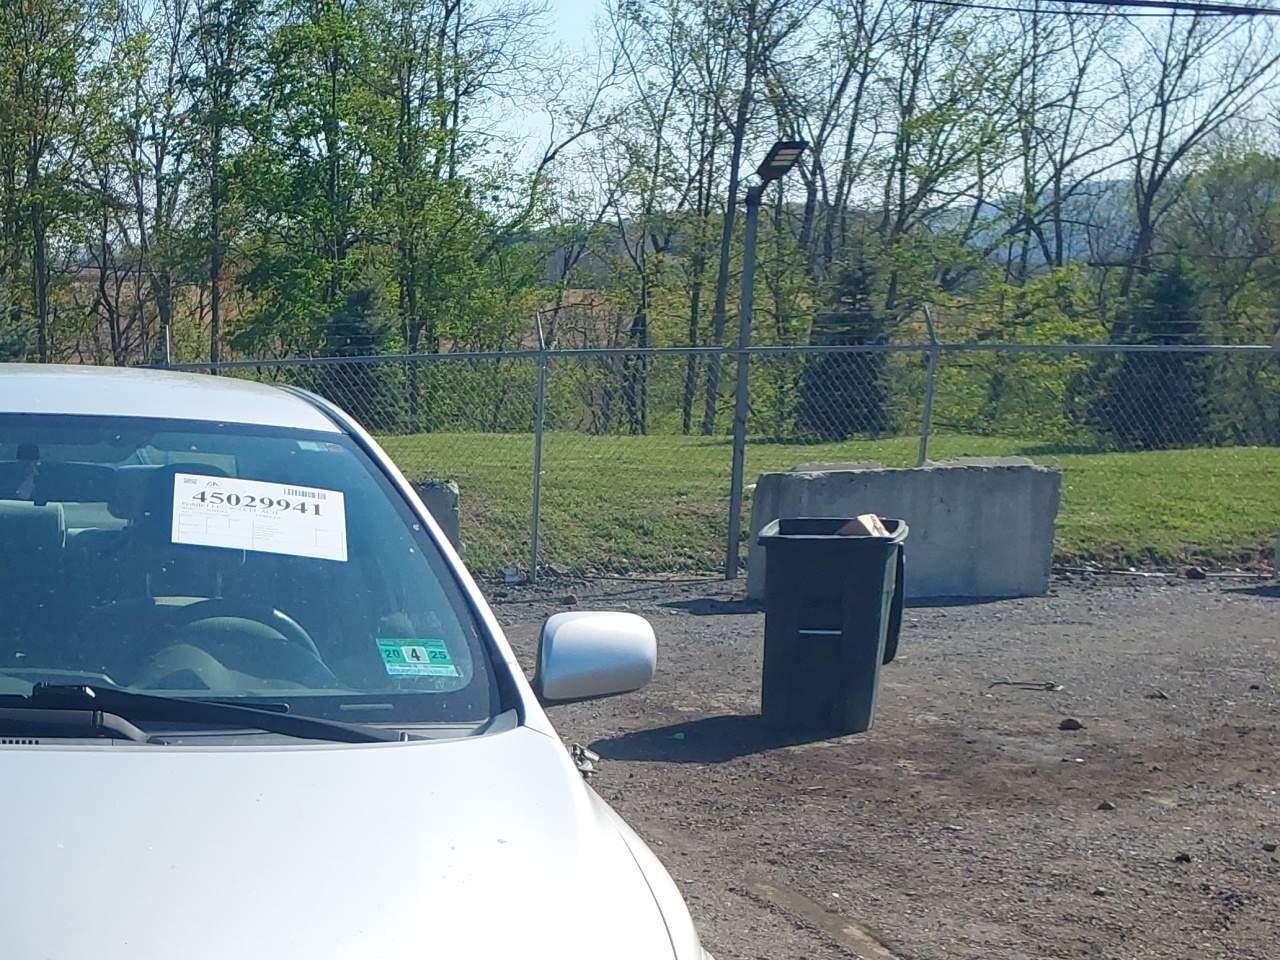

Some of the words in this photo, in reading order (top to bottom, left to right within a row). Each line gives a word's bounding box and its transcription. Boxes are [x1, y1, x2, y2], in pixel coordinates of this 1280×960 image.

[192, 490, 322, 516] 45029941
[384, 648, 400, 658] 20
[411, 648, 421, 661] 4
[430, 650, 447, 659] 25
